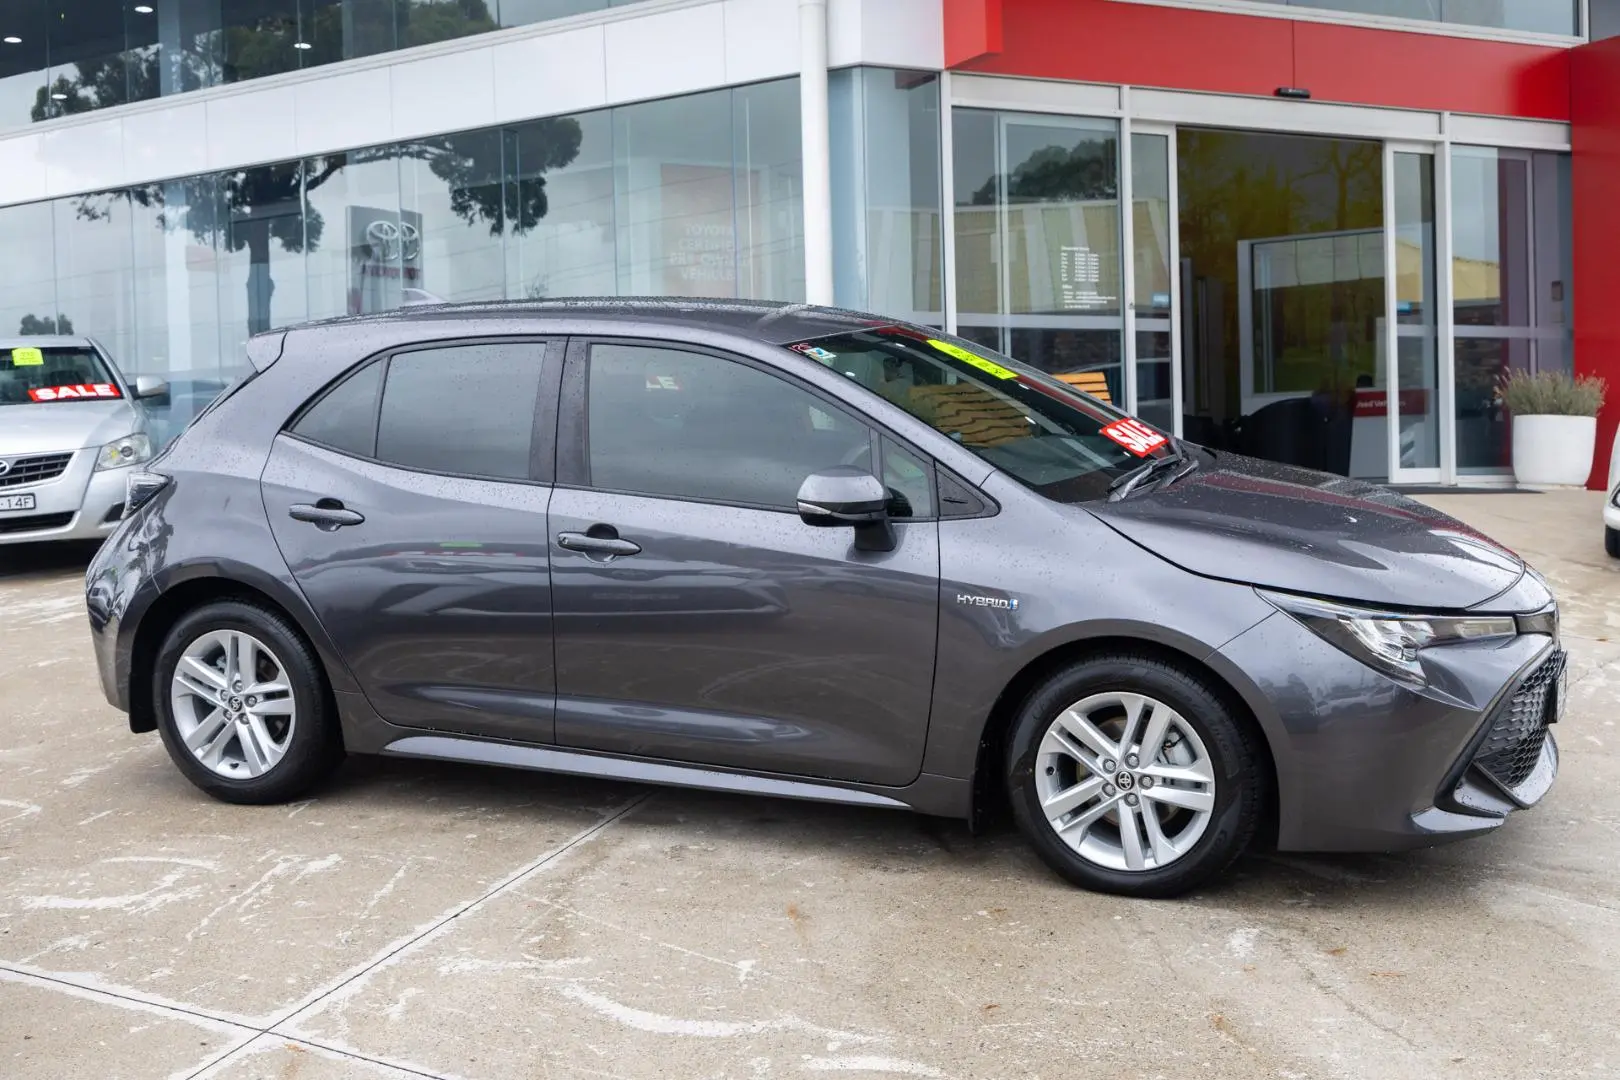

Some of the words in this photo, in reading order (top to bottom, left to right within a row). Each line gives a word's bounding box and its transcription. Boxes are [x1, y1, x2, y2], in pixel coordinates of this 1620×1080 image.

[35, 384, 115, 400] SALE
[1107, 420, 1166, 453] SALE
[957, 594, 1008, 608] HYBRID
